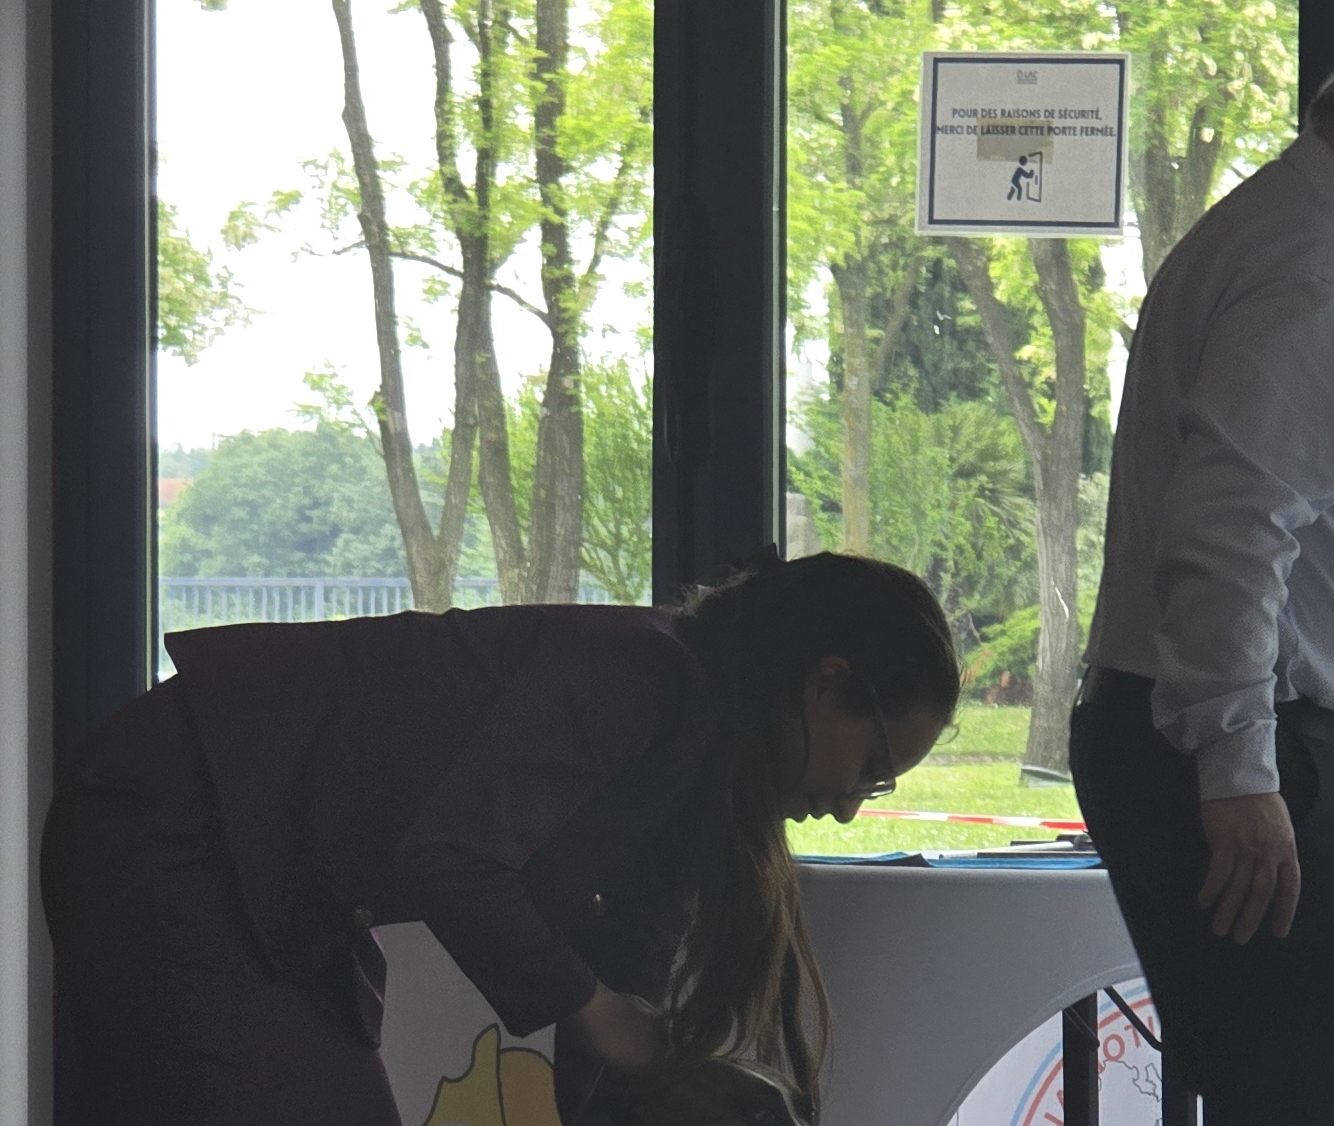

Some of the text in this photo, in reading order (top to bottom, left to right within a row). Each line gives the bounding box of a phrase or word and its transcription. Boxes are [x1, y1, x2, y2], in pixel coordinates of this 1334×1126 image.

[952, 107, 1102, 121] POUR DES RAISONS DE SÉCURITÉ,
[936, 124, 1116, 137] MERCI DE LAISSER CETTE PORTE FERMÉE.
